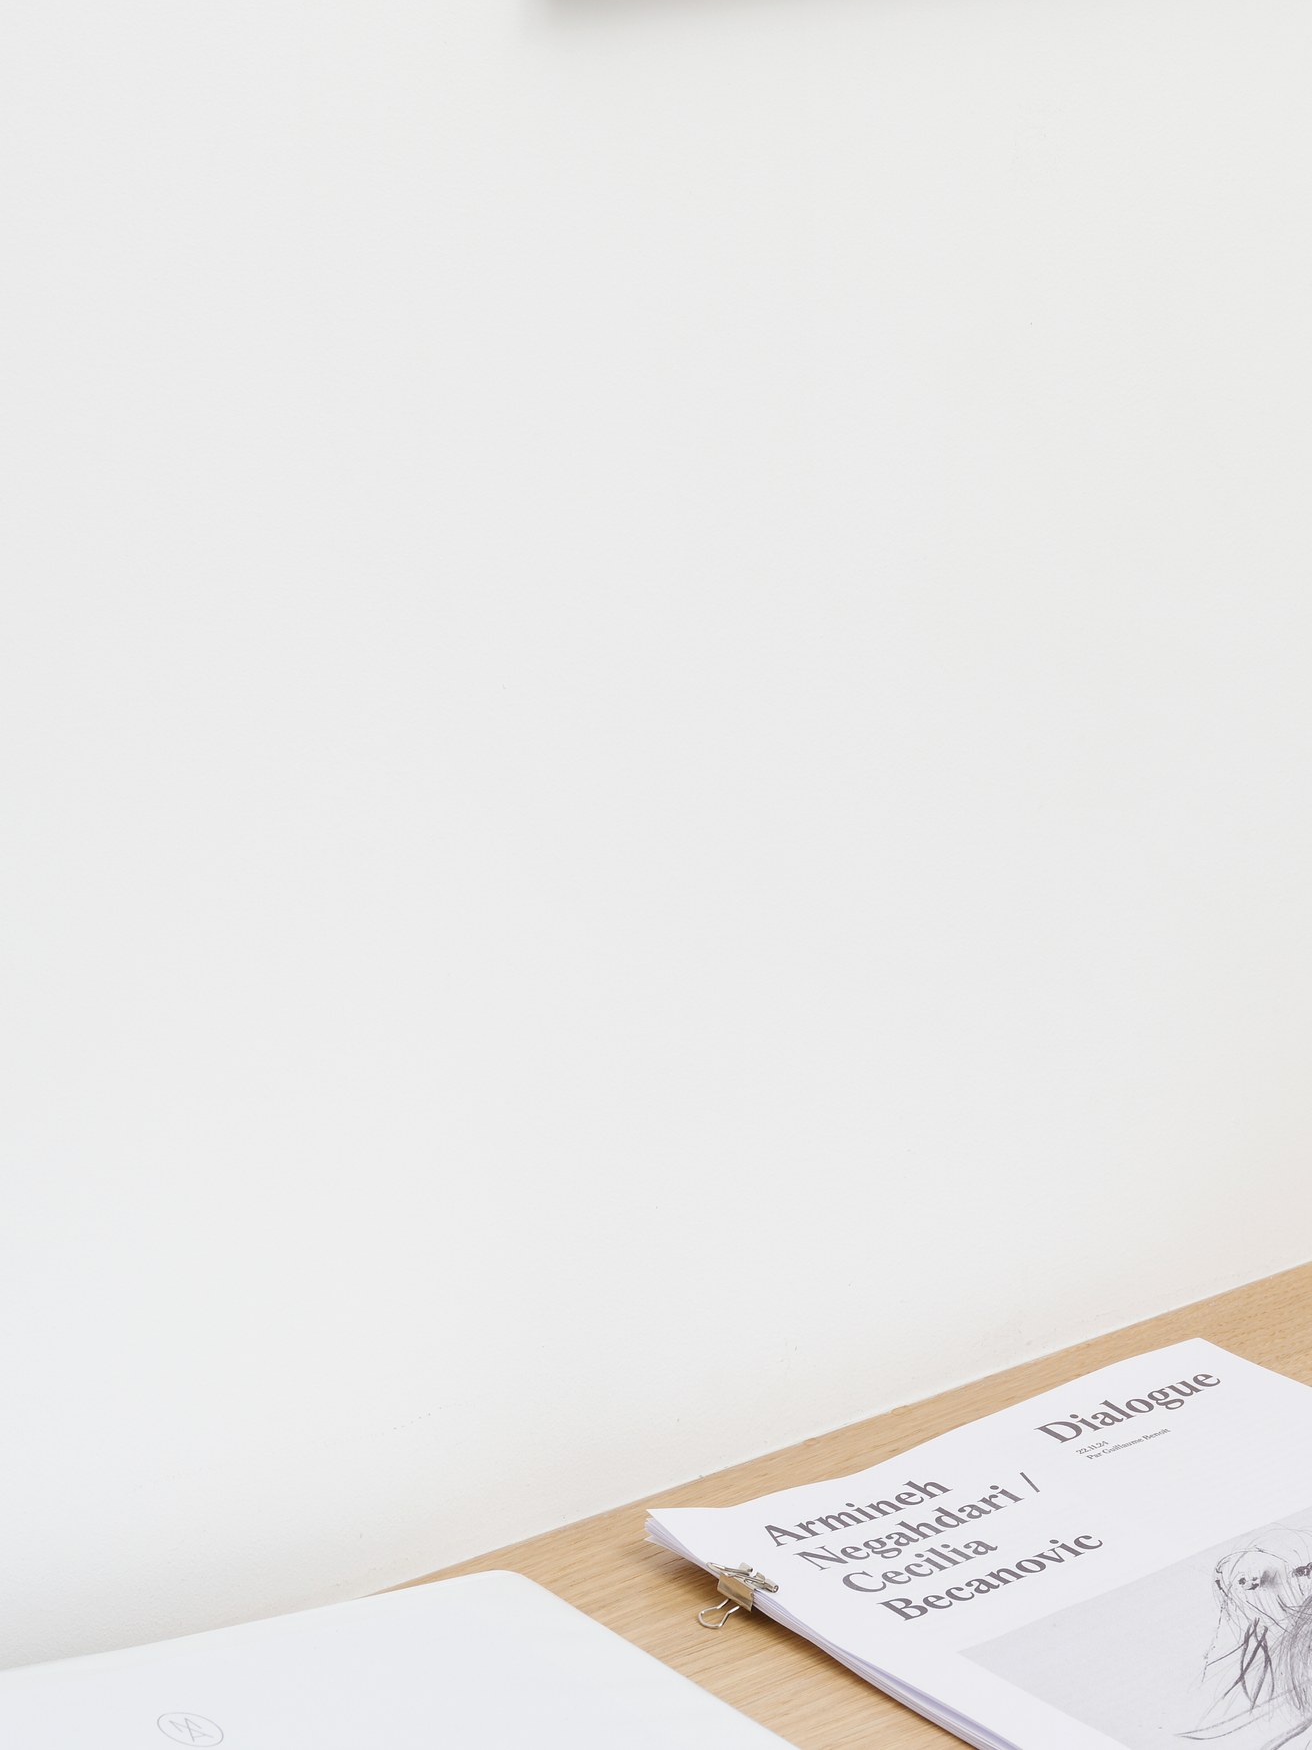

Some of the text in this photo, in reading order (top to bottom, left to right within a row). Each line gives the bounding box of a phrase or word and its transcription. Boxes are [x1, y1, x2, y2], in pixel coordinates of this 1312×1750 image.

[1035, 1368, 1221, 1444] Dialogue
[763, 1477, 953, 1548] Armineh
[793, 1483, 1025, 1572] Negahdari
[841, 1534, 998, 1593] Cecilia
[878, 1531, 1104, 1621] Becanovic
